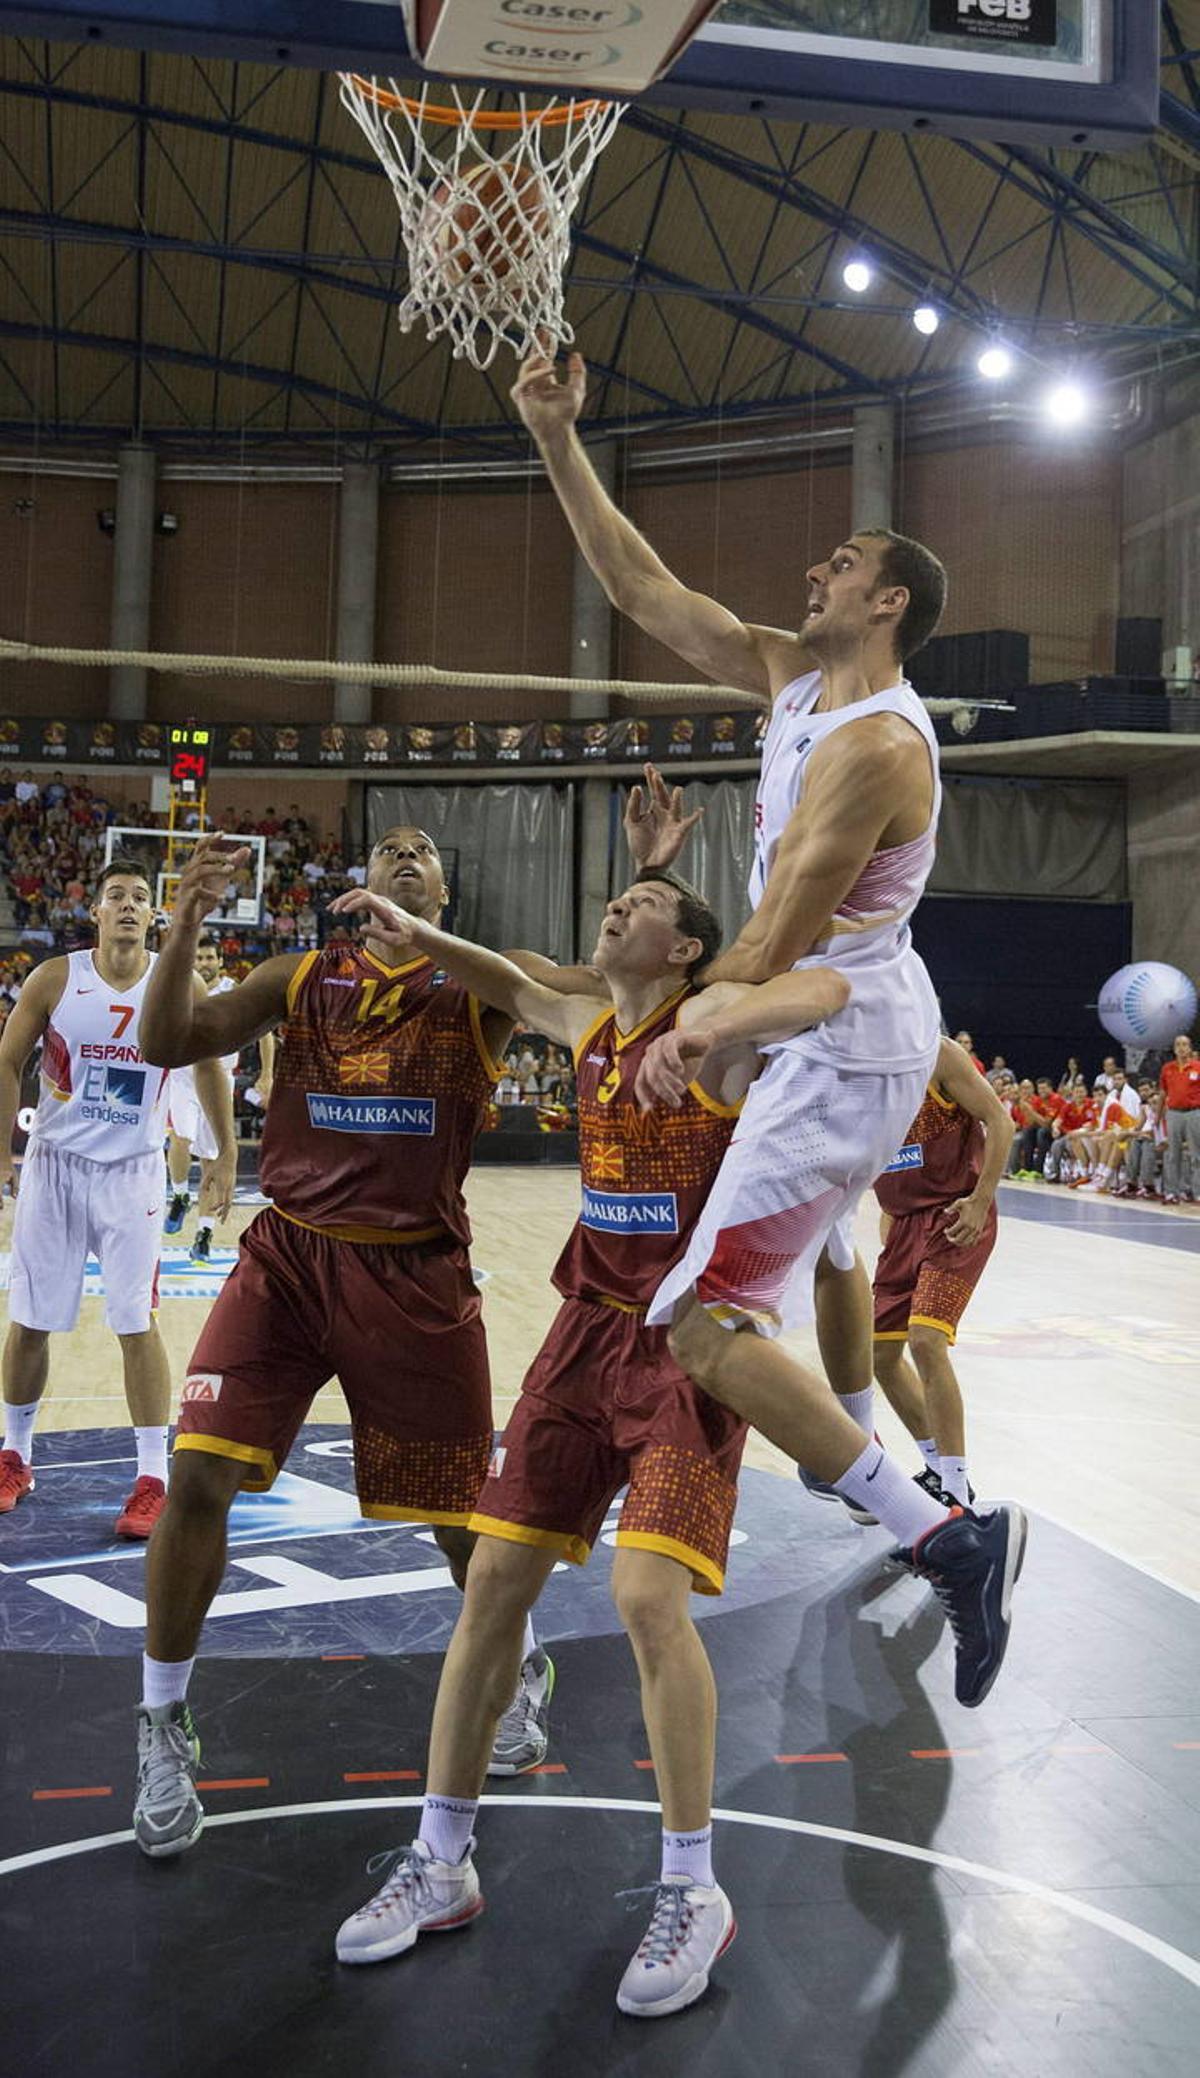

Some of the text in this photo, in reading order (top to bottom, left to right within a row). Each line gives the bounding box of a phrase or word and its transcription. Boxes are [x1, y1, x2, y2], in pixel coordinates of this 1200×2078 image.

[501, 0, 612, 22] Caser
[485, 40, 591, 62] Caser
[173, 753, 205, 778] 24
[357, 978, 405, 1024] 14
[109, 1005, 135, 1039] 7
[81, 1105, 140, 1126] endesa
[328, 1105, 430, 1124] HALKBANK
